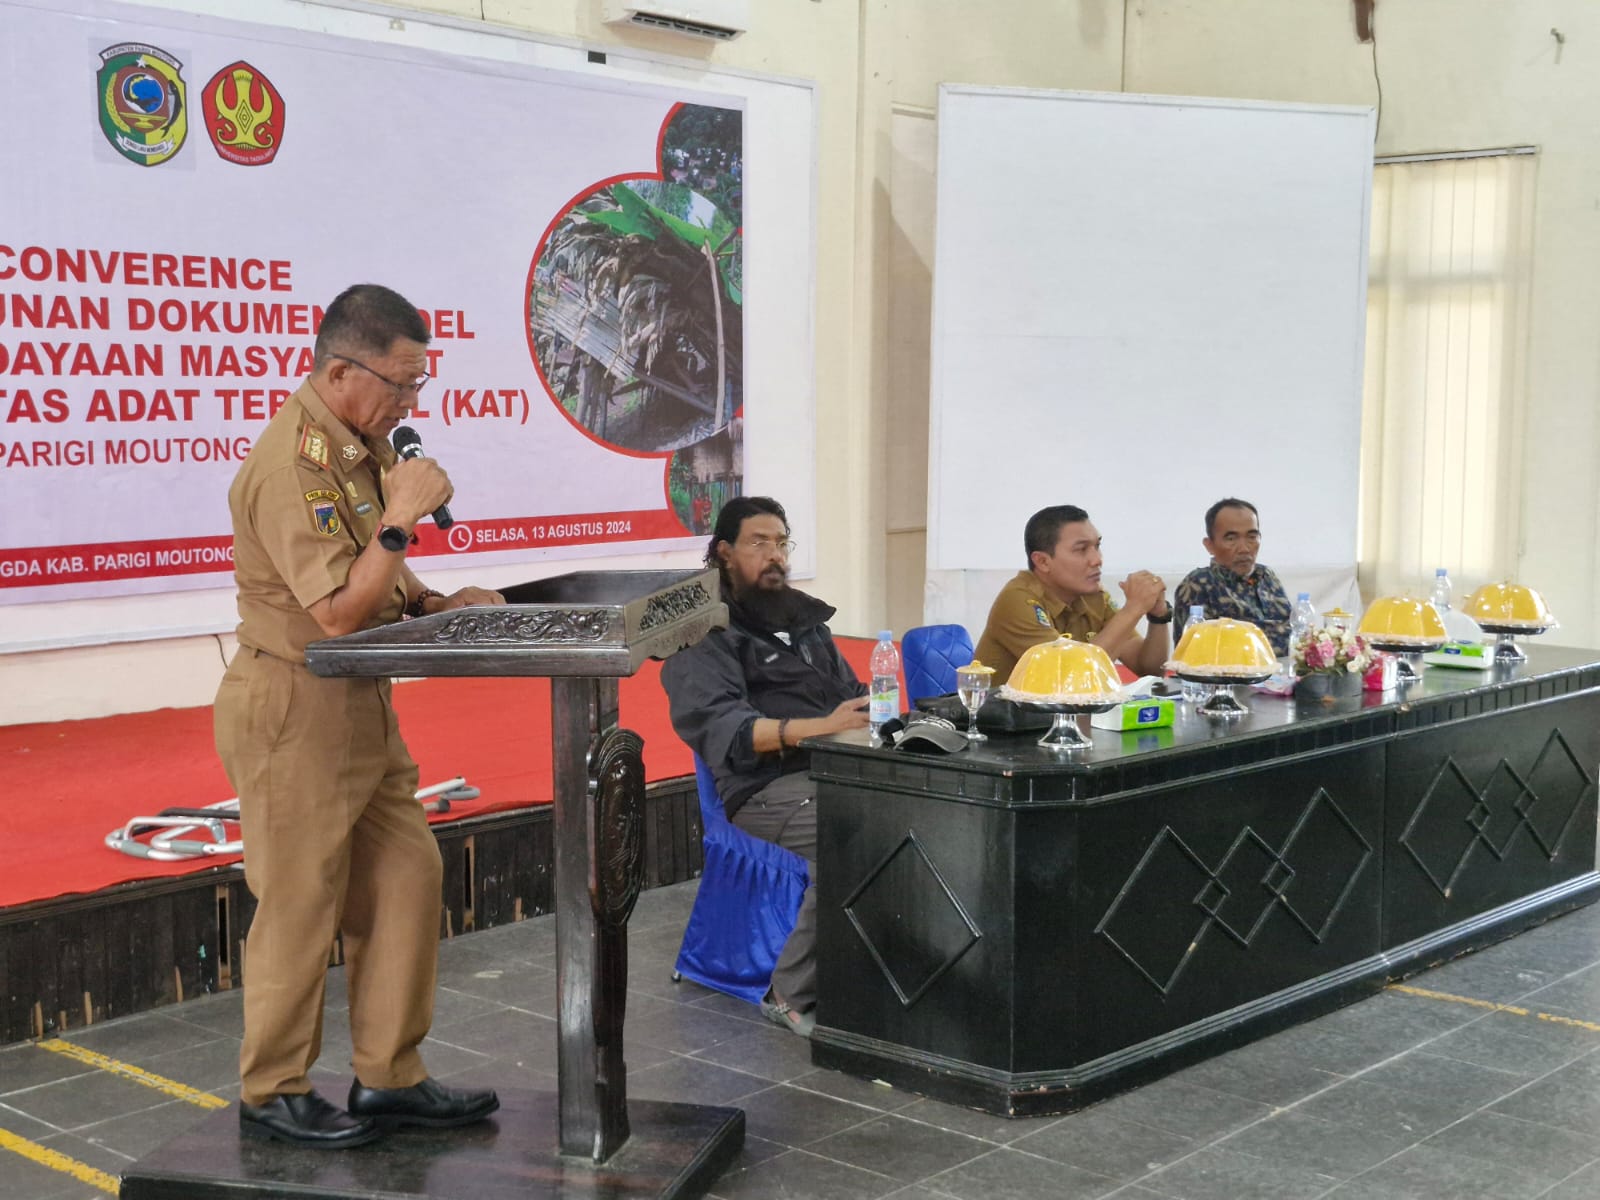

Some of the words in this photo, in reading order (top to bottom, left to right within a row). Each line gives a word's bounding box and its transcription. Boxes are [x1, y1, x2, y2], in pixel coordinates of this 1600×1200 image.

[86, 388, 200, 422] ADAT
[441, 388, 530, 426] (KAT)
[105, 437, 252, 465] MOUTONG
[476, 527, 529, 543] SELASA,
[532, 526, 545, 539] 13
[547, 522, 603, 538] AGUSTUS
[606, 520, 632, 535] 2024
[47, 556, 89, 574] KAB.
[94, 551, 151, 570] PARIGI
